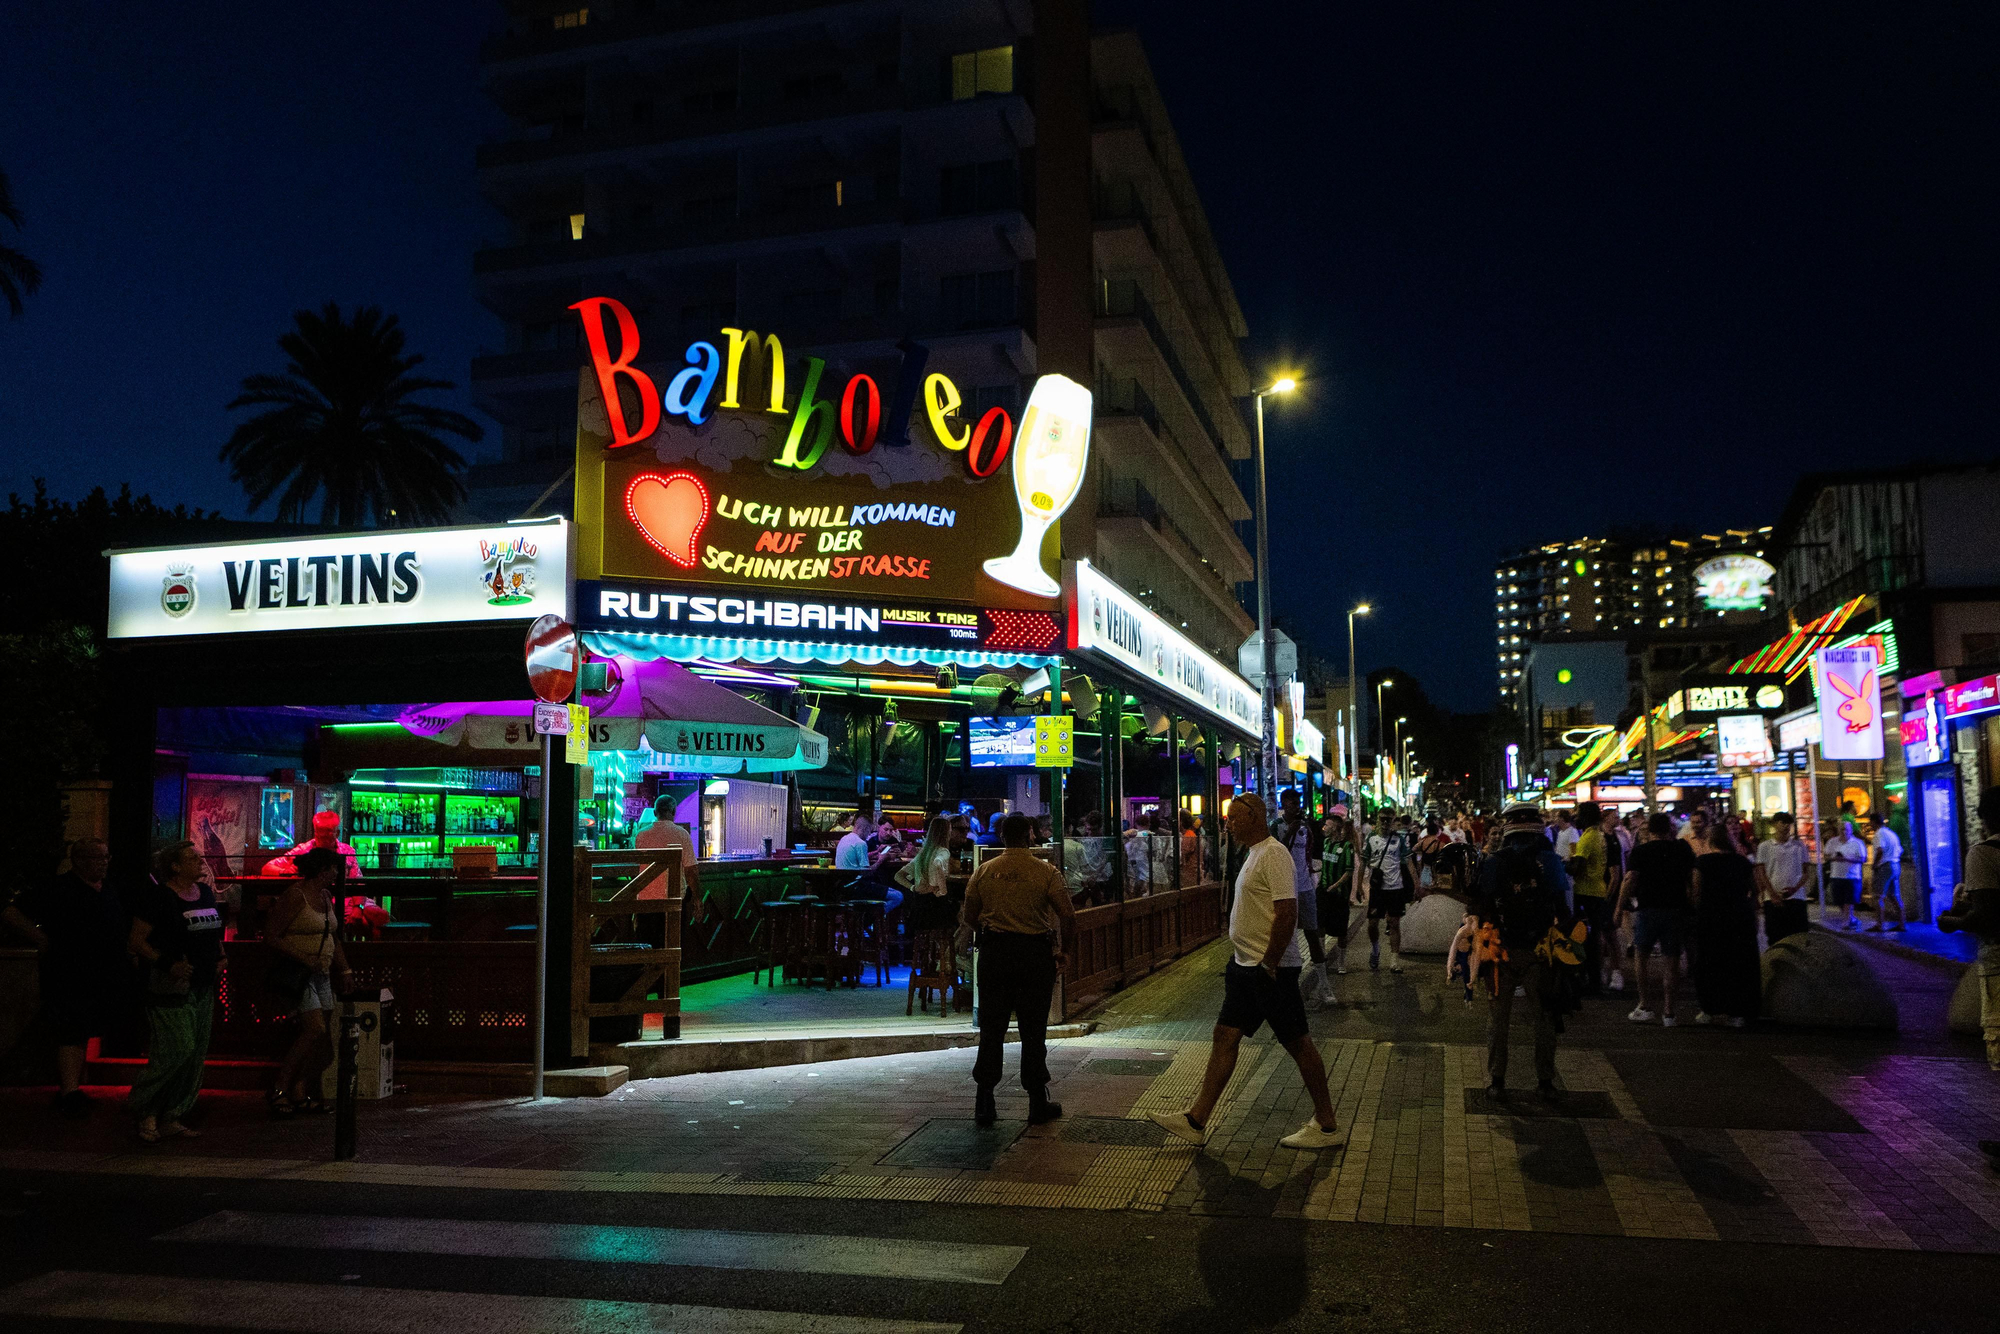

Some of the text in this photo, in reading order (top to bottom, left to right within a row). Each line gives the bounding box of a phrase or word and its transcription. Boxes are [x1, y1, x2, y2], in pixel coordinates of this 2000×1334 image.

[568, 296, 1013, 478] Bamboleo
[1031, 494, 1052, 508] 0,0%
[789, 503, 956, 529] WILLKOMMEN
[479, 537, 537, 561] Bamboleo
[755, 529, 863, 553] AUF DER
[701, 544, 931, 580] SCHINKENSTRASSE
[223, 551, 420, 611] VELTINS
[599, 590, 879, 632] RUTSCHBAHN
[882, 609, 978, 626] MUSIK TANZ
[949, 628, 978, 639] 100mts.
[1106, 597, 1142, 659] VELTINS
[1183, 652, 1205, 696] VELTINS
[1690, 687, 1749, 699] PARTY
[692, 732, 765, 752] VELTINS
